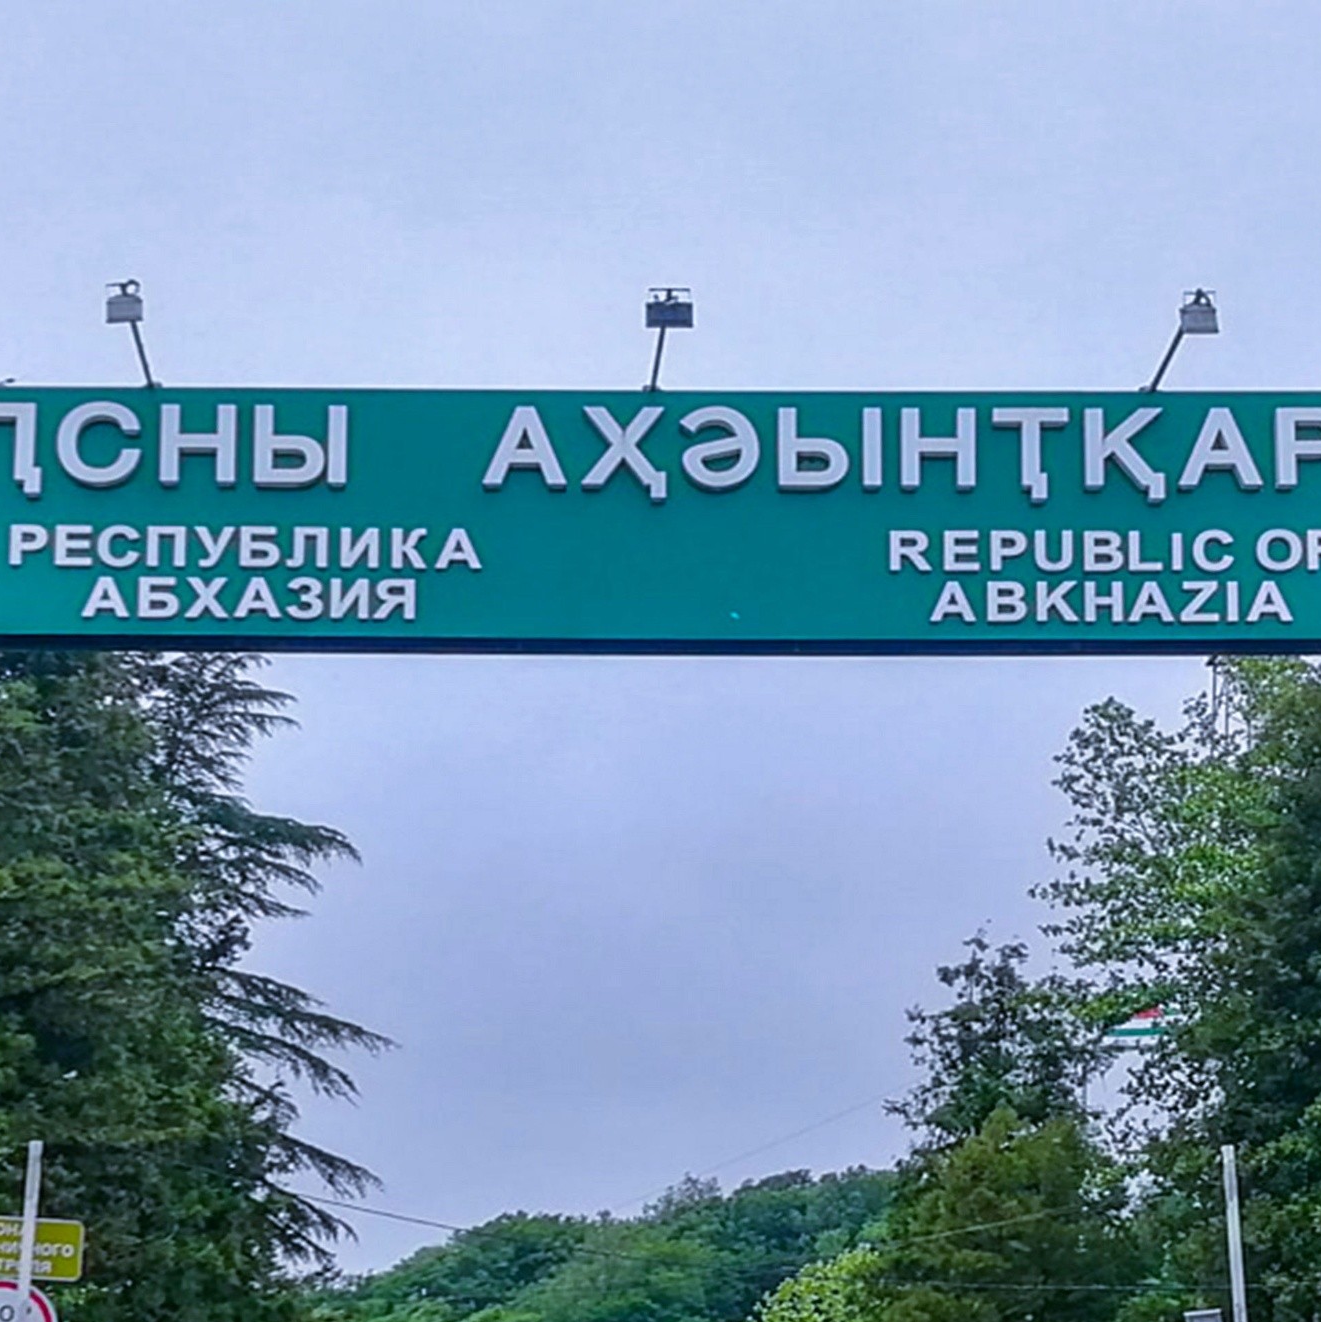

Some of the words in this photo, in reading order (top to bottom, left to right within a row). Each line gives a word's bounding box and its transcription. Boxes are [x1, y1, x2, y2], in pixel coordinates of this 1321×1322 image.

[7, 524, 482, 570] РЕСПУБЛИКА
[886, 528, 1235, 572] REPUBLIC
[81, 575, 420, 621] АБХАЗИЯ
[928, 579, 1295, 623] ABKHAZIA
